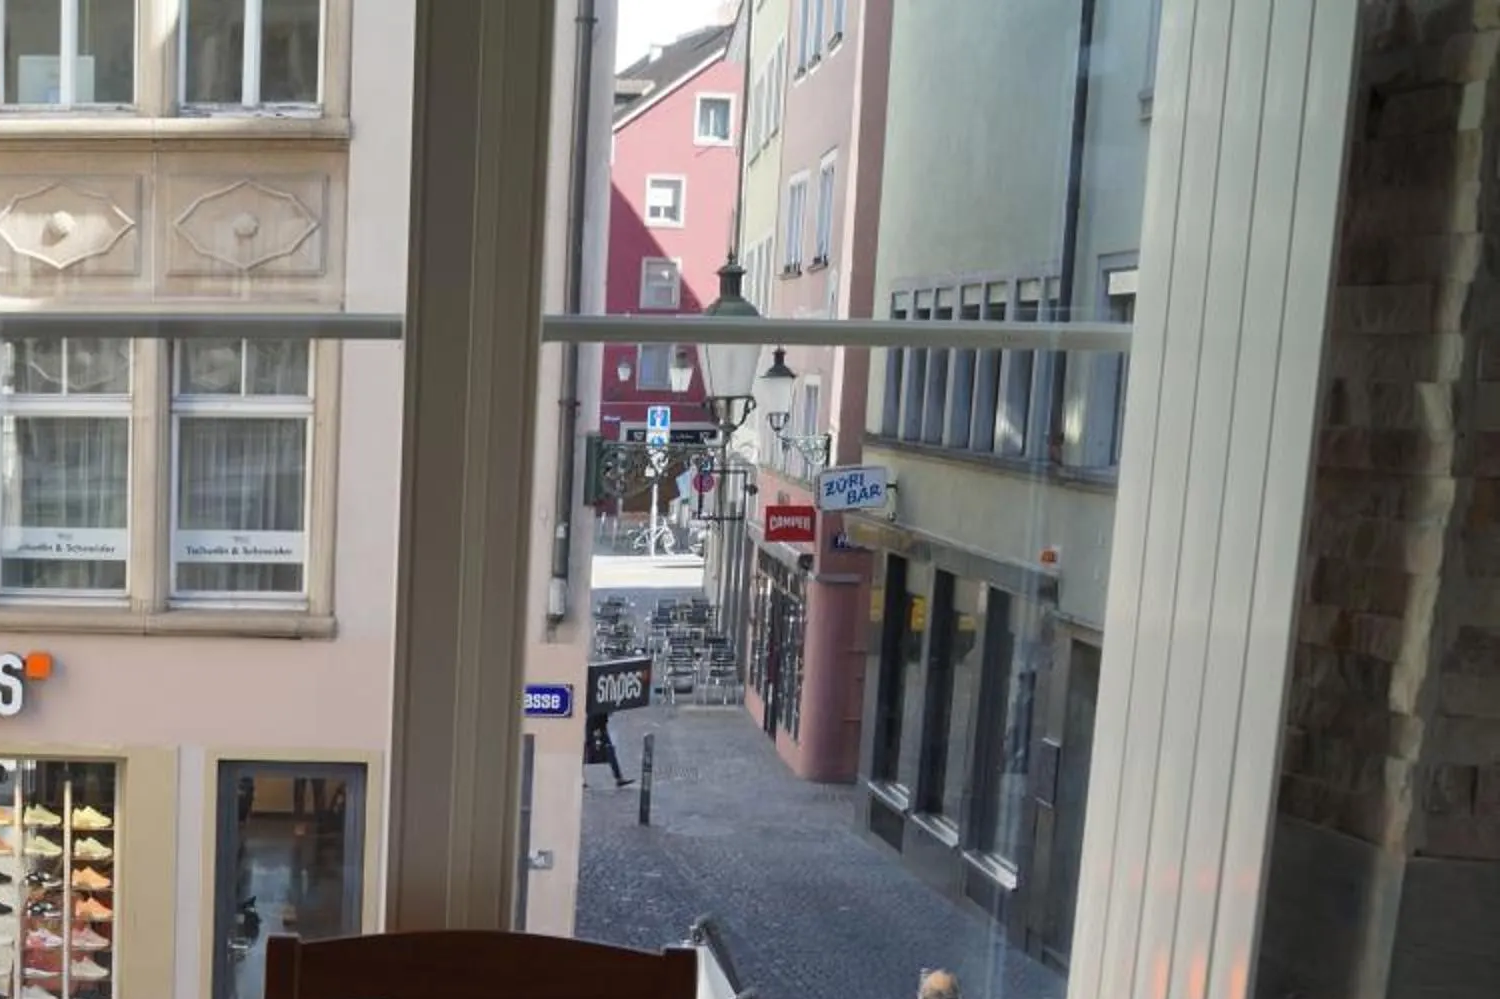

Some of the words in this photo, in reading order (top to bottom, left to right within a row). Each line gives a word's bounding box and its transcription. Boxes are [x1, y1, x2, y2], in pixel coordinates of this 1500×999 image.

[846, 483, 882, 505] BAR
[231, 546, 239, 555] &
[596, 671, 642, 707] snipes
